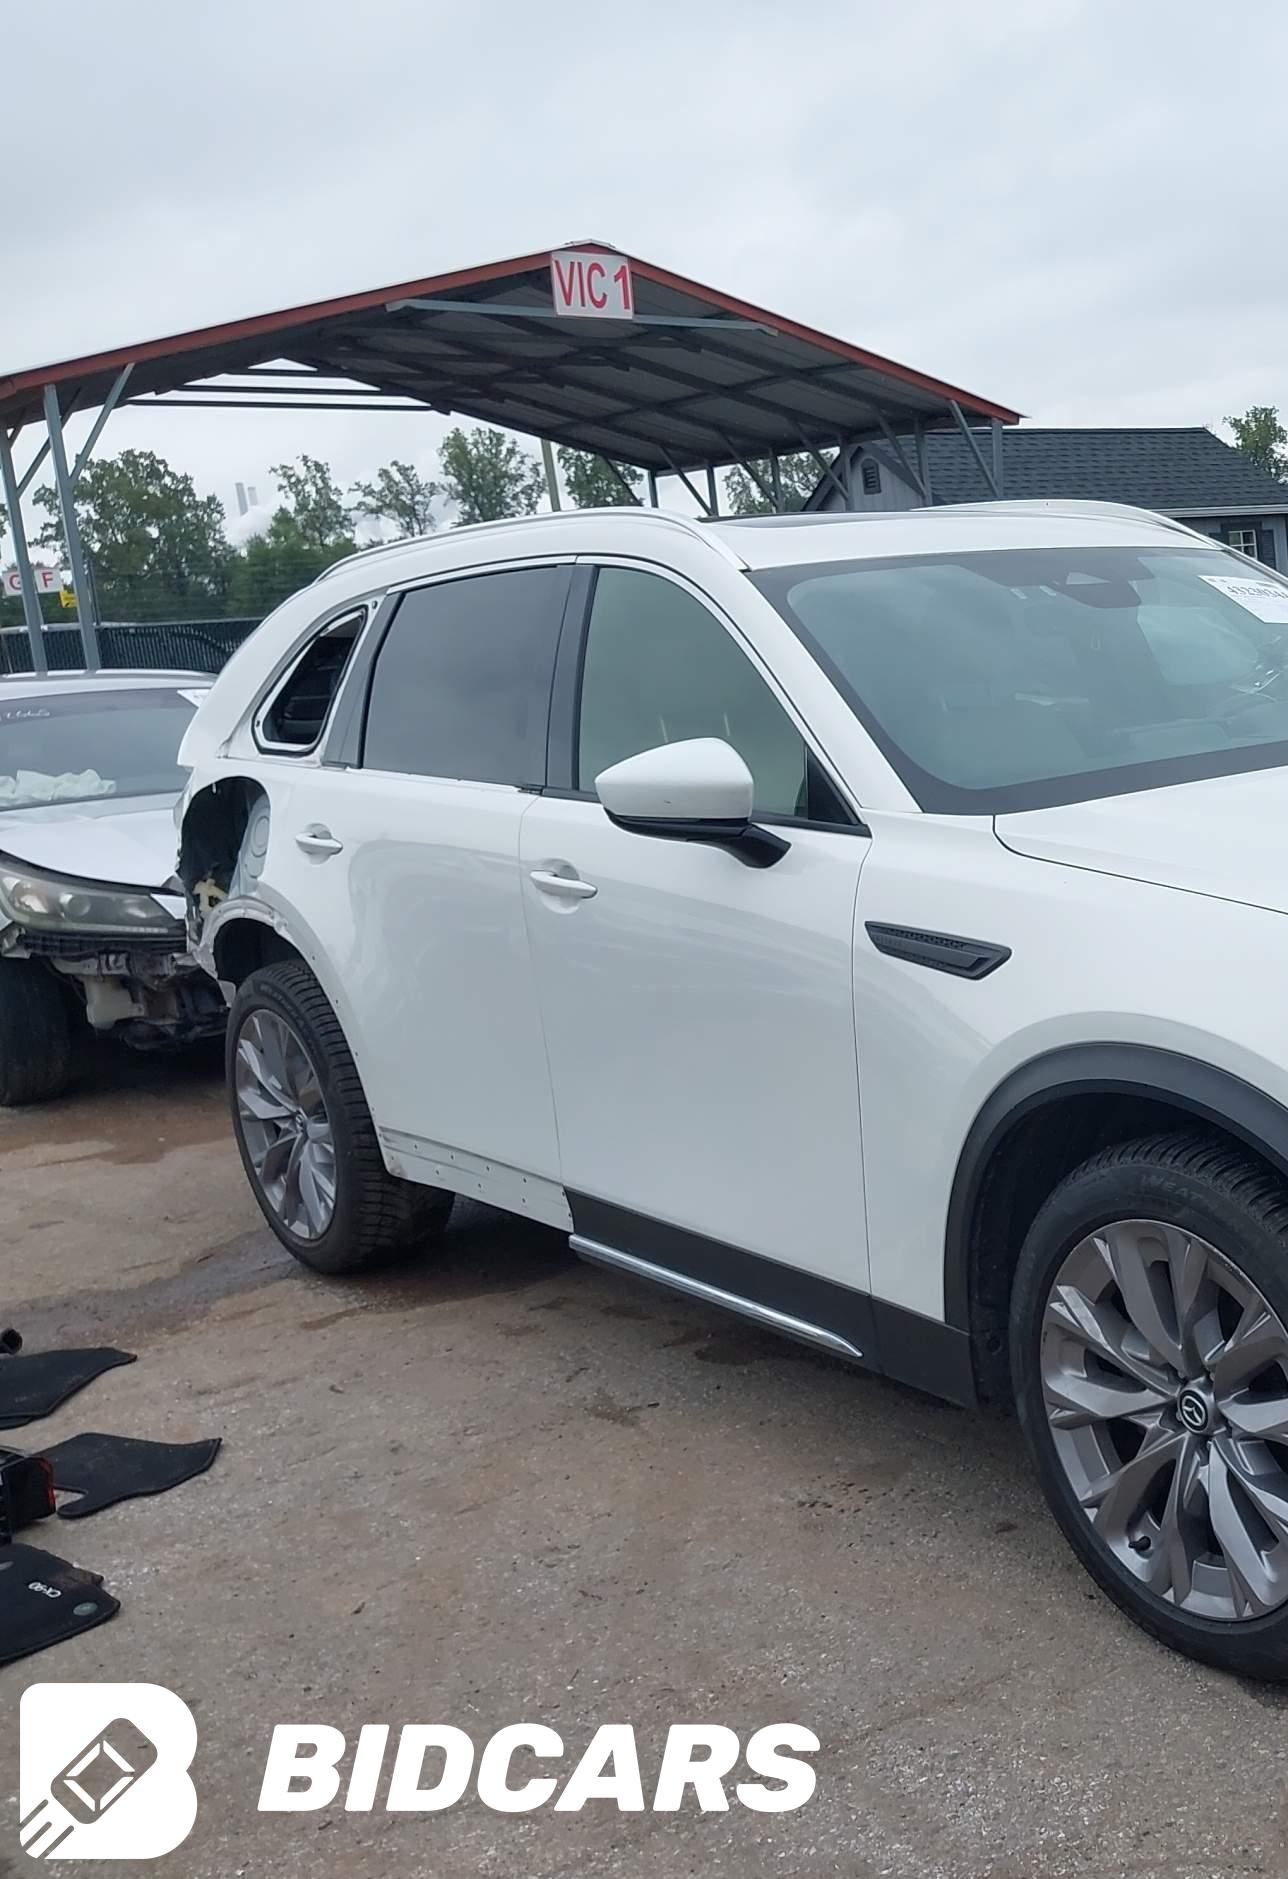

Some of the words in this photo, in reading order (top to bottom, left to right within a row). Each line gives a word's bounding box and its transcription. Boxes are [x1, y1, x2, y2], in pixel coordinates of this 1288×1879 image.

[554, 260, 608, 309] VIC
[613, 265, 631, 310] 1
[41, 571, 54, 588] F
